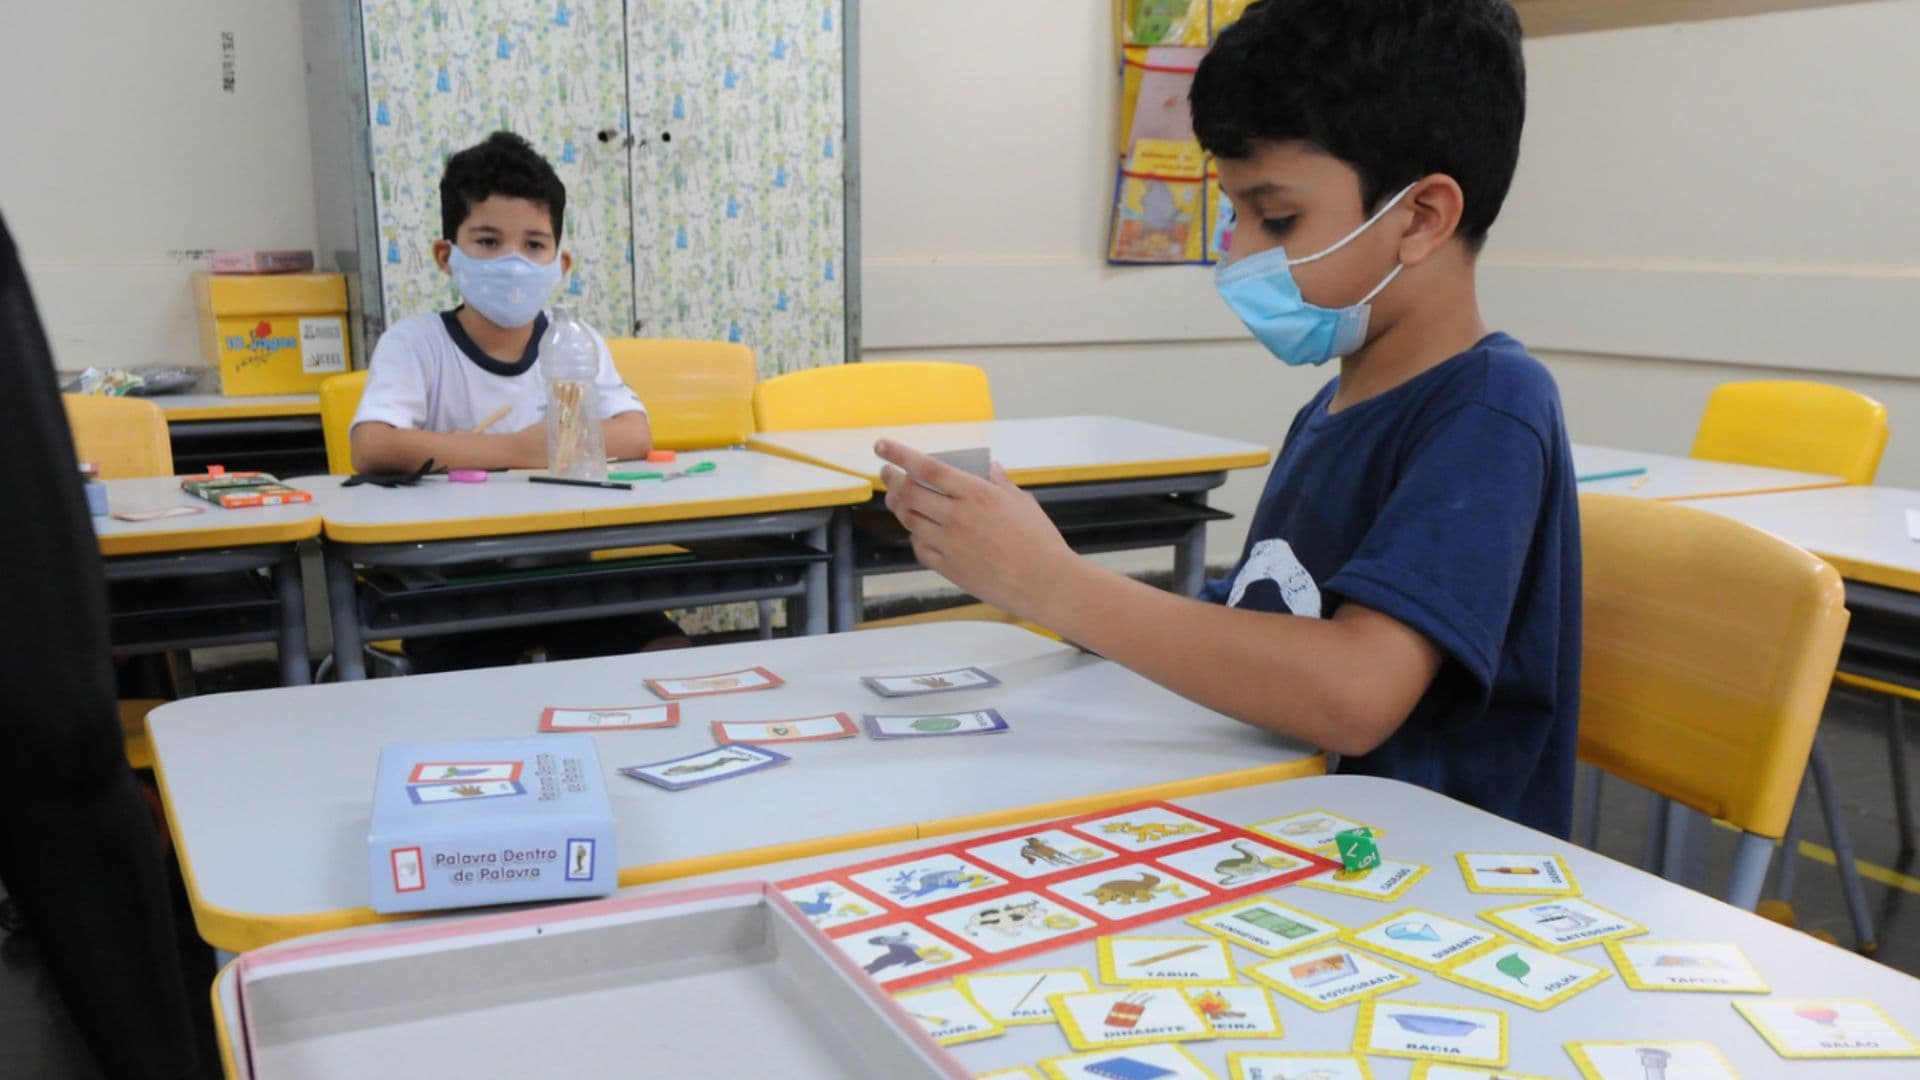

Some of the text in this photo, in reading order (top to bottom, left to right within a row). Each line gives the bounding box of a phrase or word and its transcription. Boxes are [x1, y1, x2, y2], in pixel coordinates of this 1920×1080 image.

[436, 849, 557, 865] Palavra Dentro
[453, 867, 540, 881] de Palavra
[959, 873, 996, 888] 2
[1156, 883, 1187, 898] 7
[1432, 935, 1484, 958] DIAMANTE
[915, 946, 954, 964] 5
[1147, 970, 1199, 978] TÁBUA
[1318, 974, 1399, 1000] FOTOGRAFIA
[1545, 974, 1578, 992] FOLHA
[931, 1025, 978, 1038] OURA
[1103, 1026, 1186, 1038] DINAMITE
[1406, 1043, 1461, 1054] BACIA
